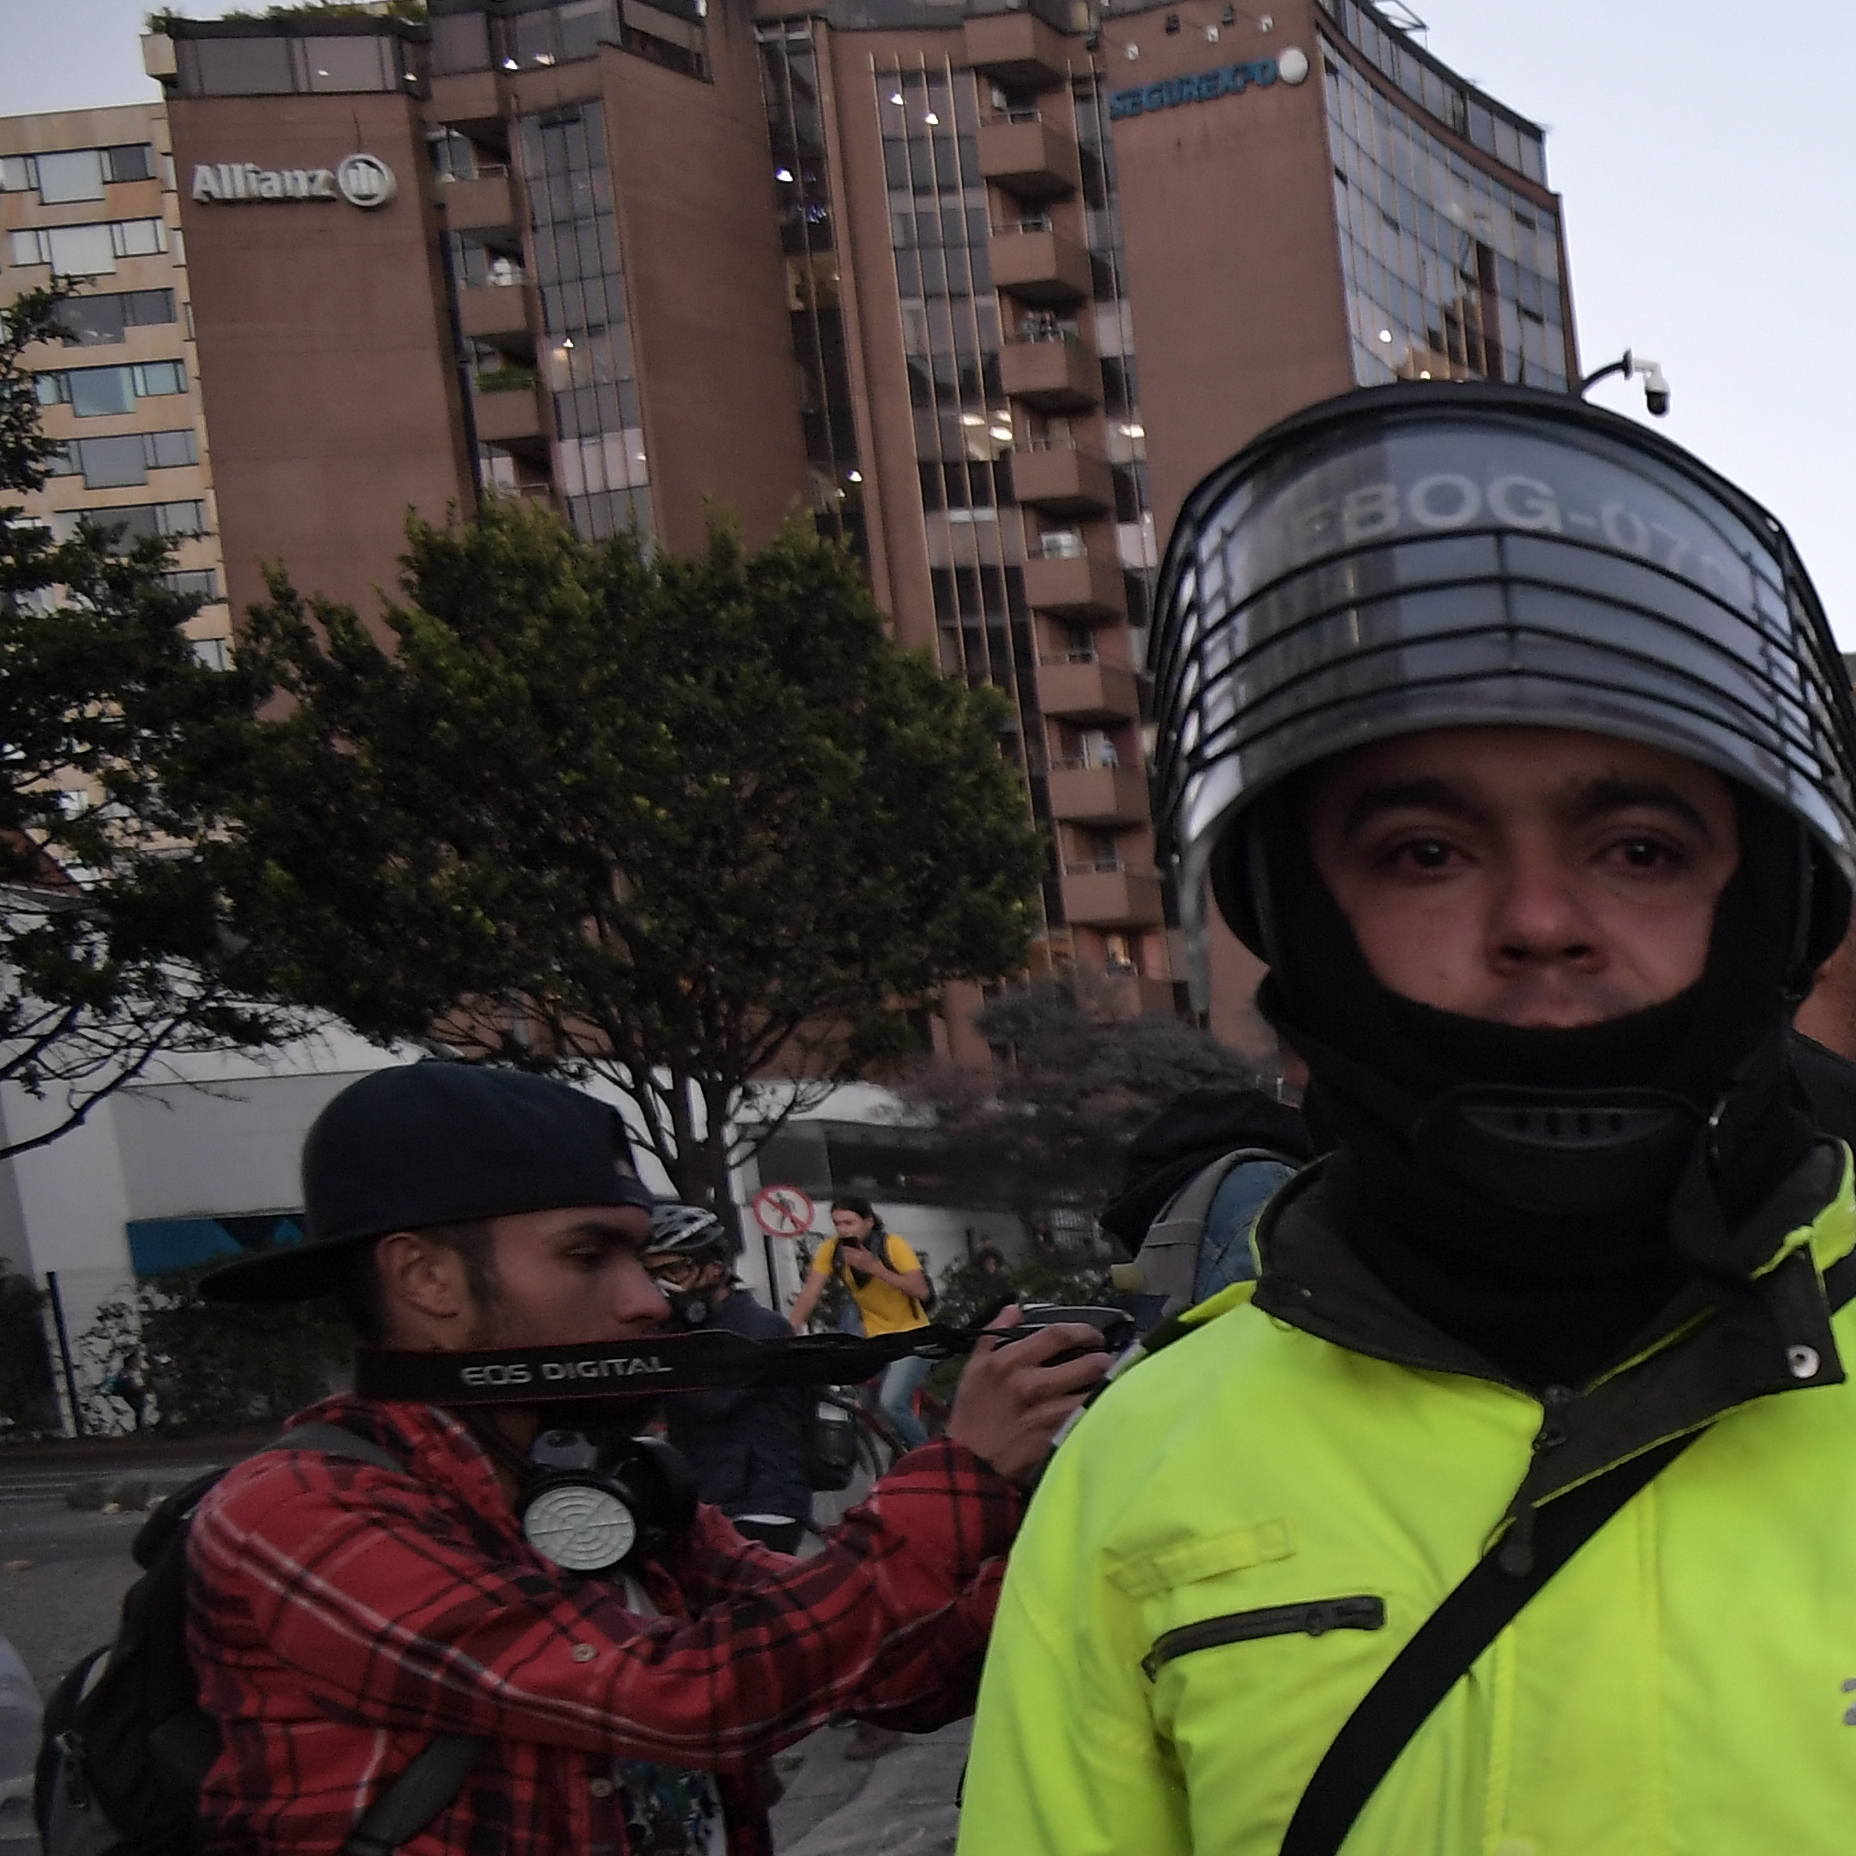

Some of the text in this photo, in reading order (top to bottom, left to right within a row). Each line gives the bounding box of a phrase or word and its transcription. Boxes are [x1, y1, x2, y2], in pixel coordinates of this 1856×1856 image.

[192, 162, 338, 204] Allianz
[460, 1355, 674, 1387] EOS DIGITAL
